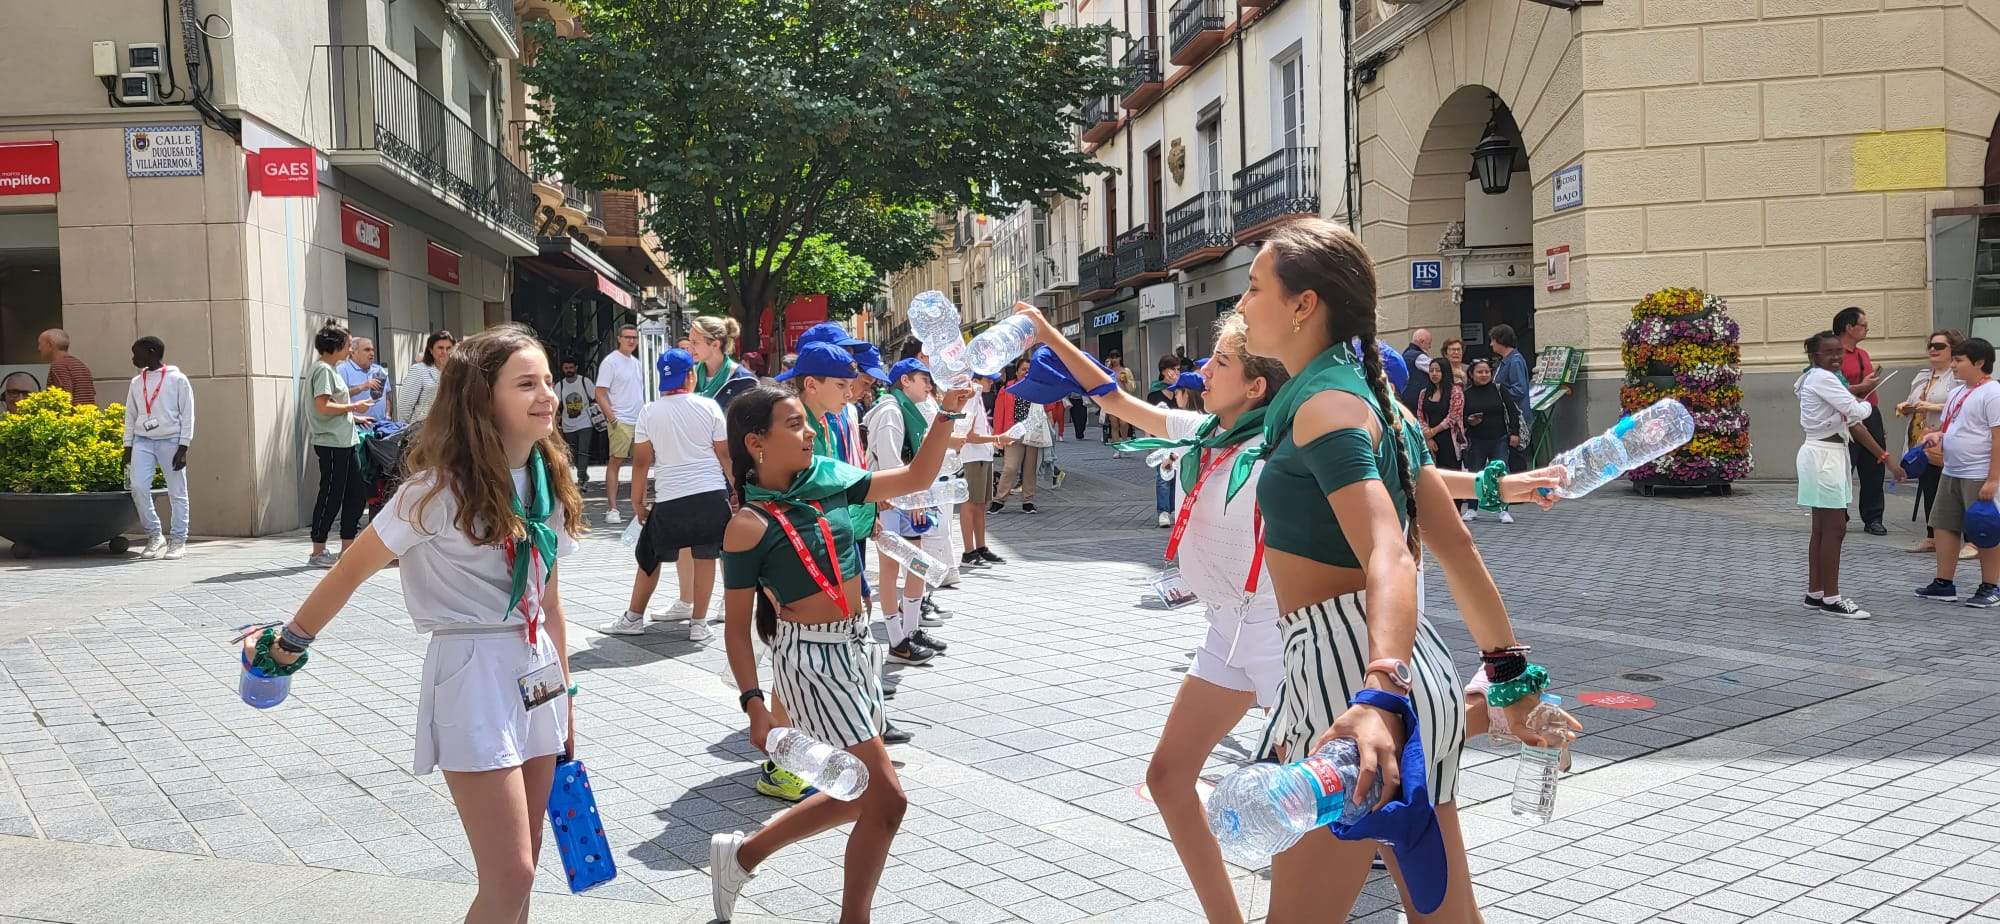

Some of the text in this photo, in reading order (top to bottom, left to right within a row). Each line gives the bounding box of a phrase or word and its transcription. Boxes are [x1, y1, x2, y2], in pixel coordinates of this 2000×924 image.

[155, 135, 192, 145] CALLE
[152, 146, 194, 157] DUQUESA DE
[136, 158, 193, 169] VILLAHERMOSA
[264, 162, 309, 176] GAES
[1556, 190, 1578, 202] BAJO
[355, 219, 381, 249] GAES
[1415, 263, 1438, 279] HS
